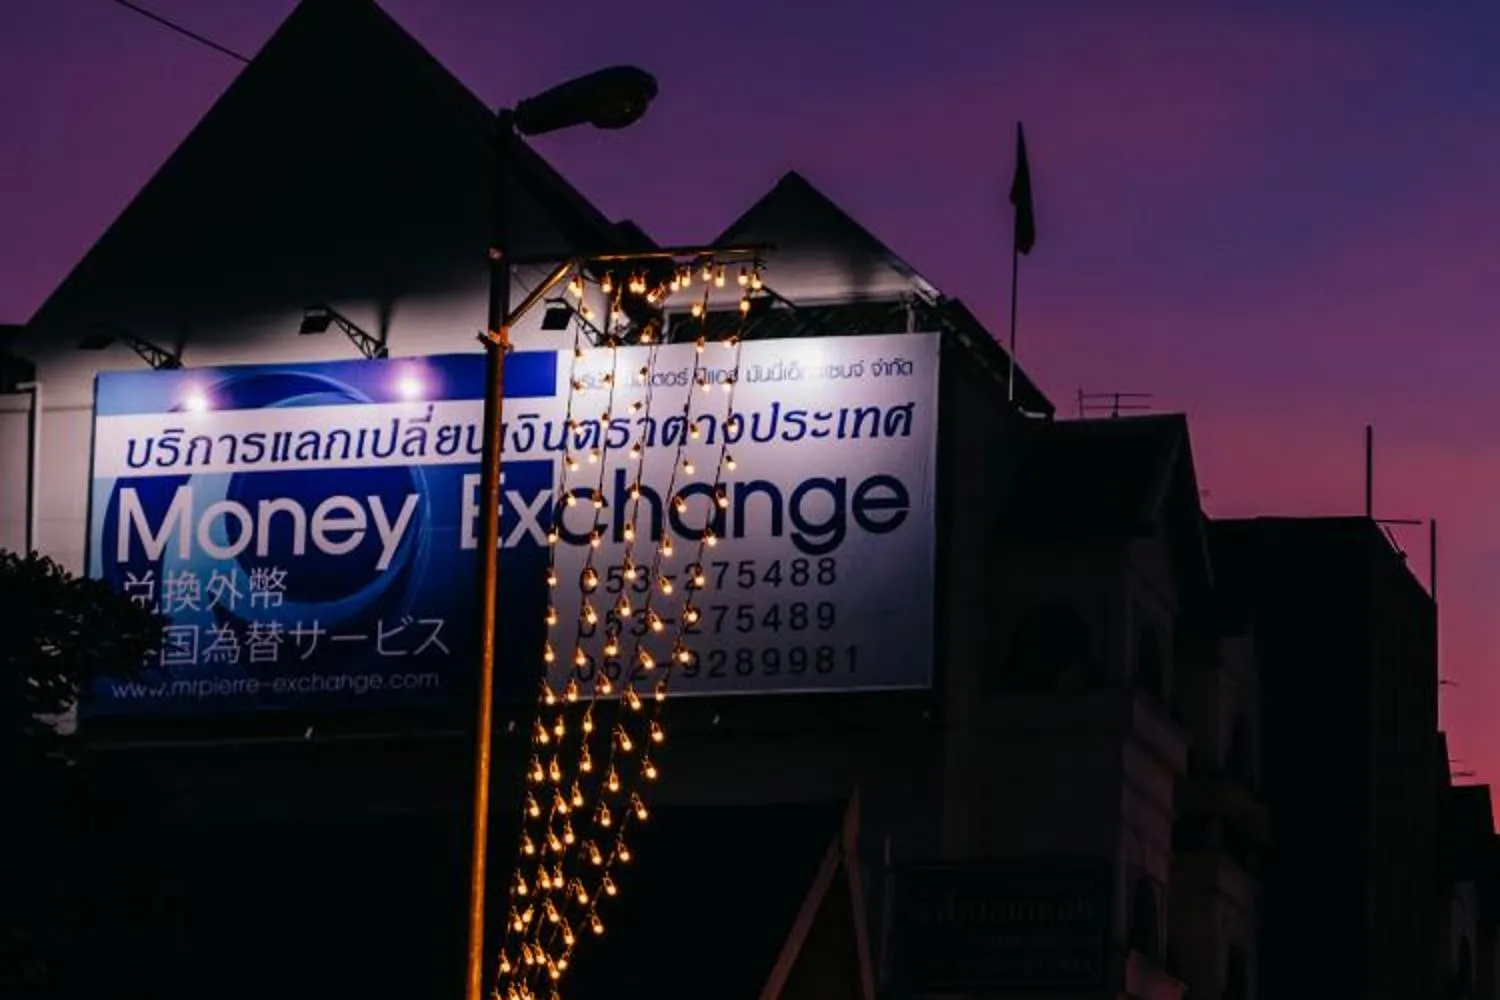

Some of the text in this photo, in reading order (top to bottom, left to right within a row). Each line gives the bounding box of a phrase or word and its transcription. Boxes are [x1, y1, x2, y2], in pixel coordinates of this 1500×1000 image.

[116, 469, 910, 570] Money Exchange
[579, 557, 837, 594] 053-275488
[578, 602, 836, 638] 053-275489
[143, 616, 450, 668] 国為替サービス
[111, 671, 440, 700] www.mrpierre-exchange.com
